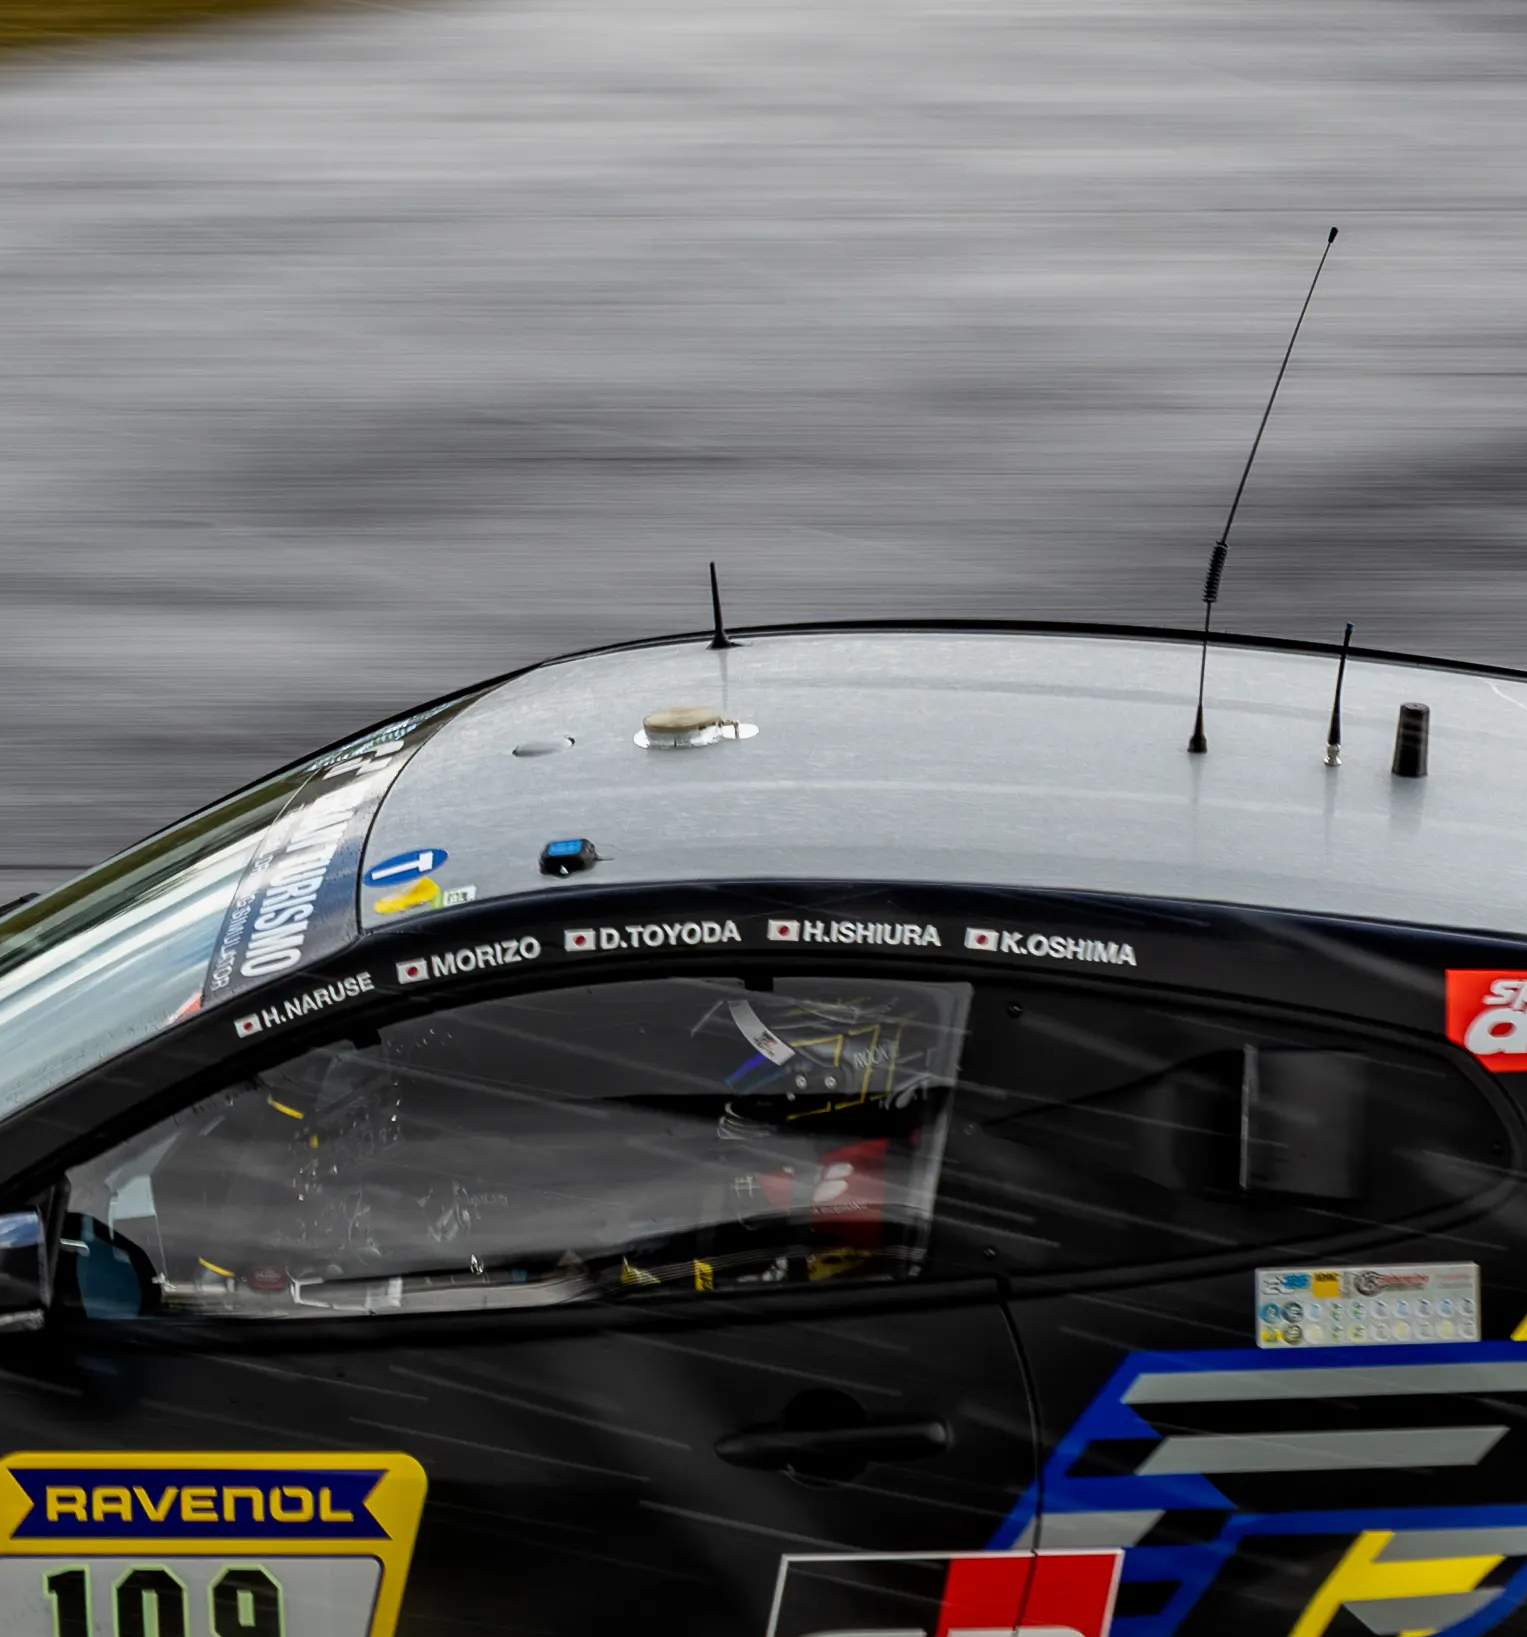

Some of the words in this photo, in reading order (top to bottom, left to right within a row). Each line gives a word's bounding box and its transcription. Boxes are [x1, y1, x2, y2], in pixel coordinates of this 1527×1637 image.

[240, 836, 346, 978] TURISMO
[600, 920, 742, 951] D.TOYODA
[802, 919, 942, 947] H.ISHIURA
[1000, 930, 1138, 966] K.OSHIMA
[431, 935, 543, 979] MORIZO
[261, 972, 377, 1030] H.NARUSE
[45, 1486, 356, 1523] RAVENOL
